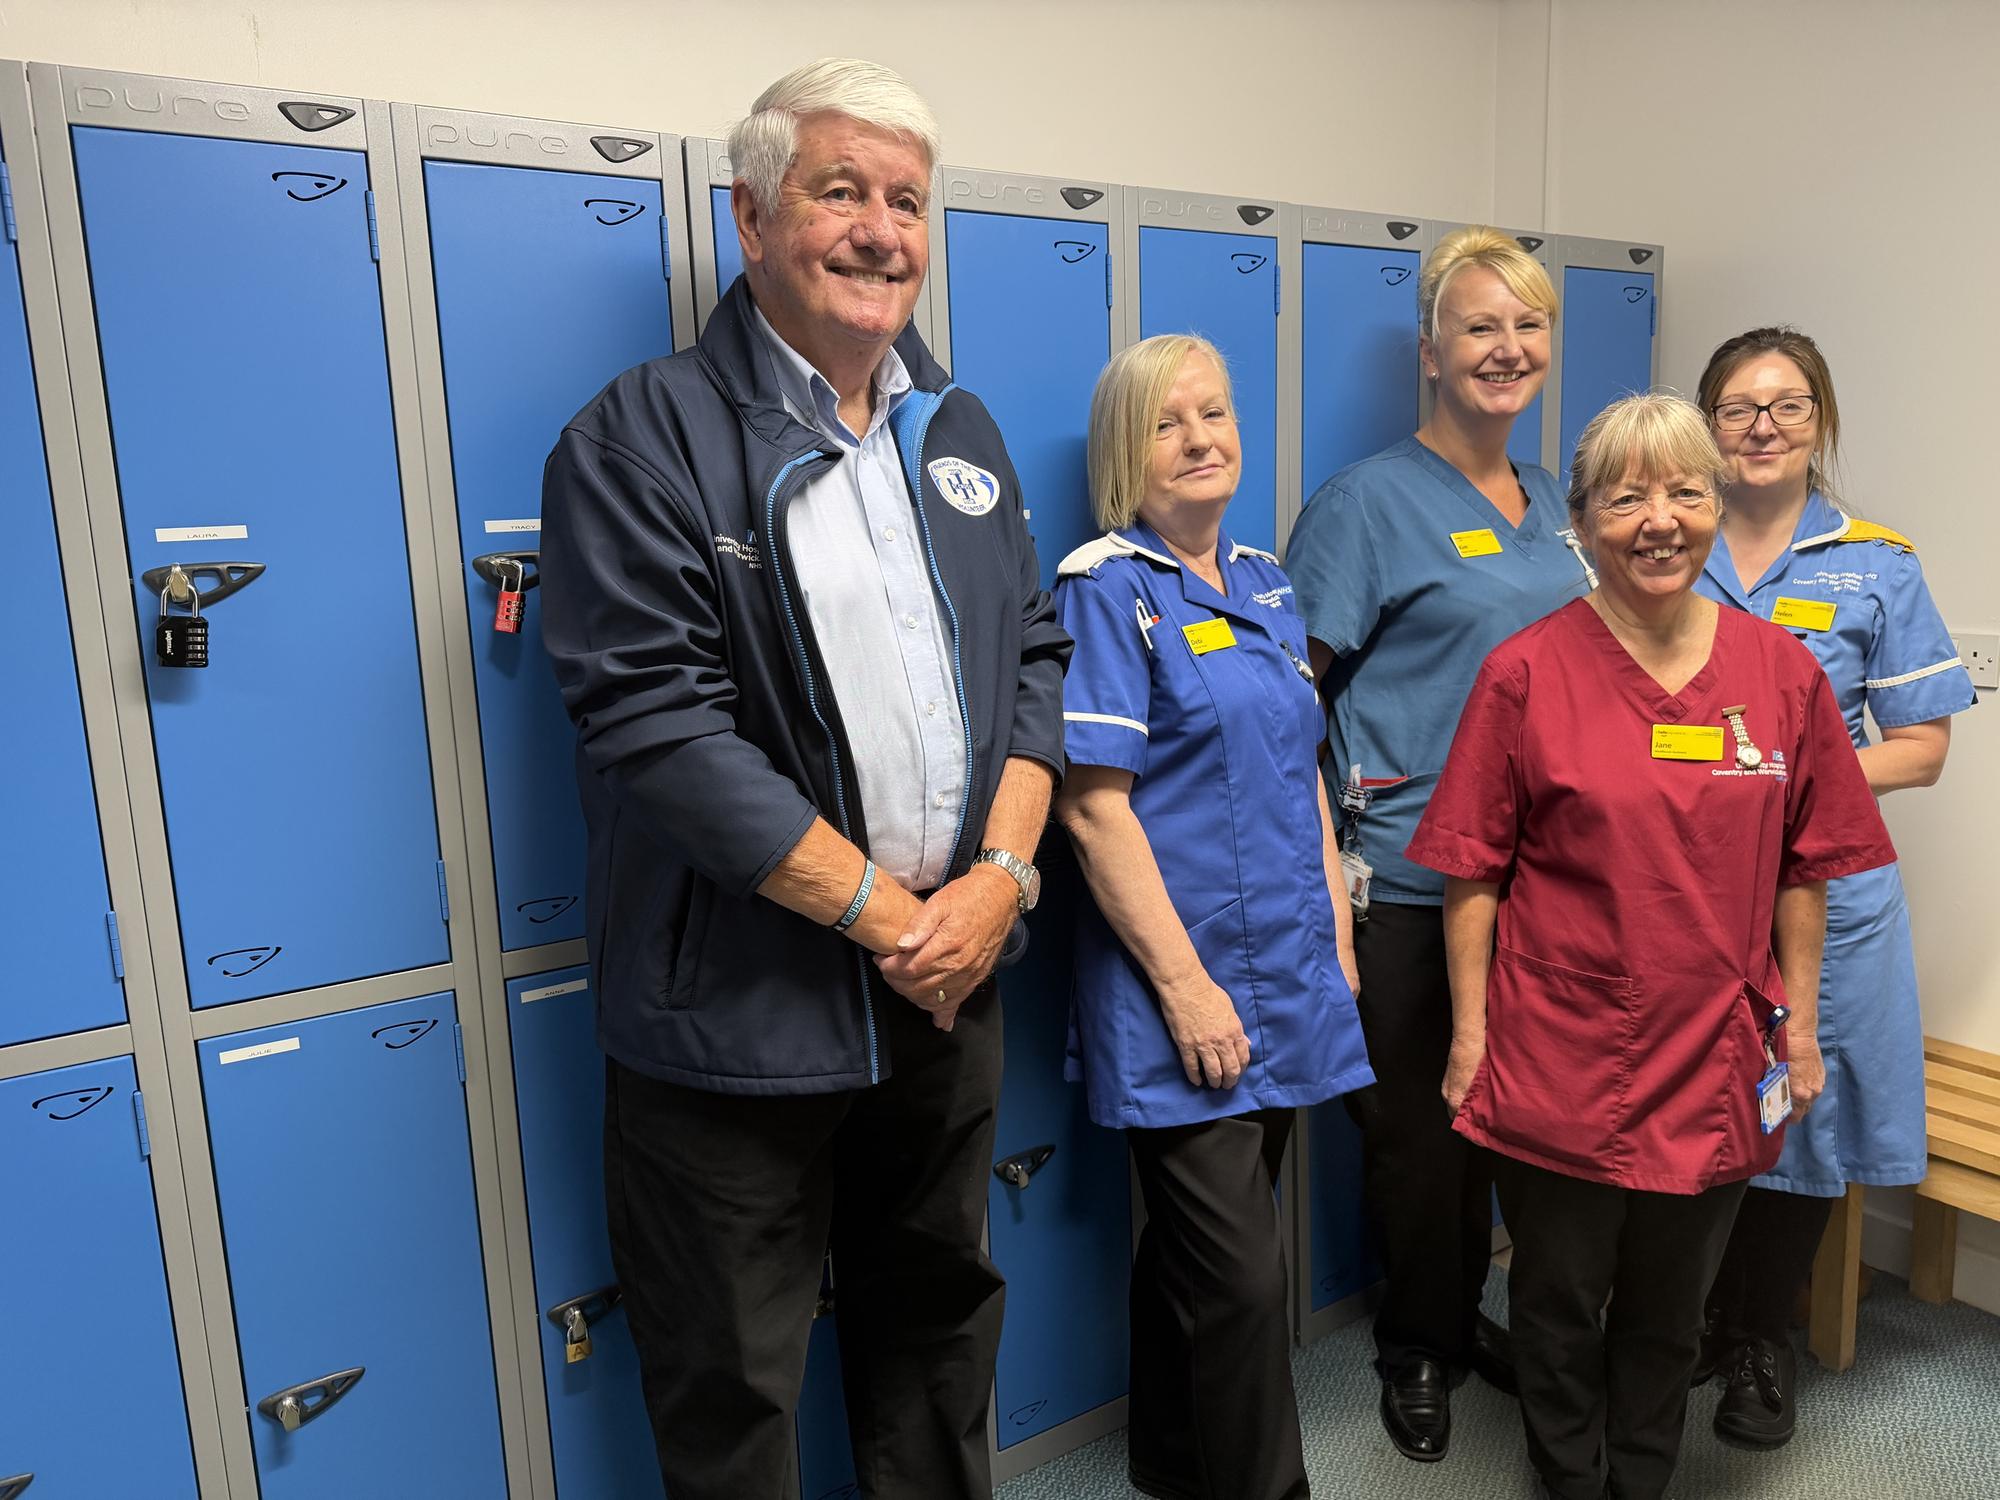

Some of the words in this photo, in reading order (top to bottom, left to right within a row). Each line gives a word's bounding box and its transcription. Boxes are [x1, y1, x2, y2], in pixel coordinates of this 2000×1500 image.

[75, 86, 250, 121] pure
[427, 124, 568, 154] pure
[950, 179, 1045, 203] pure
[1143, 199, 1225, 221] pure
[717, 545, 733, 553] and
[1655, 741, 1673, 749] Jane
[1711, 769, 1743, 777] Coventry
